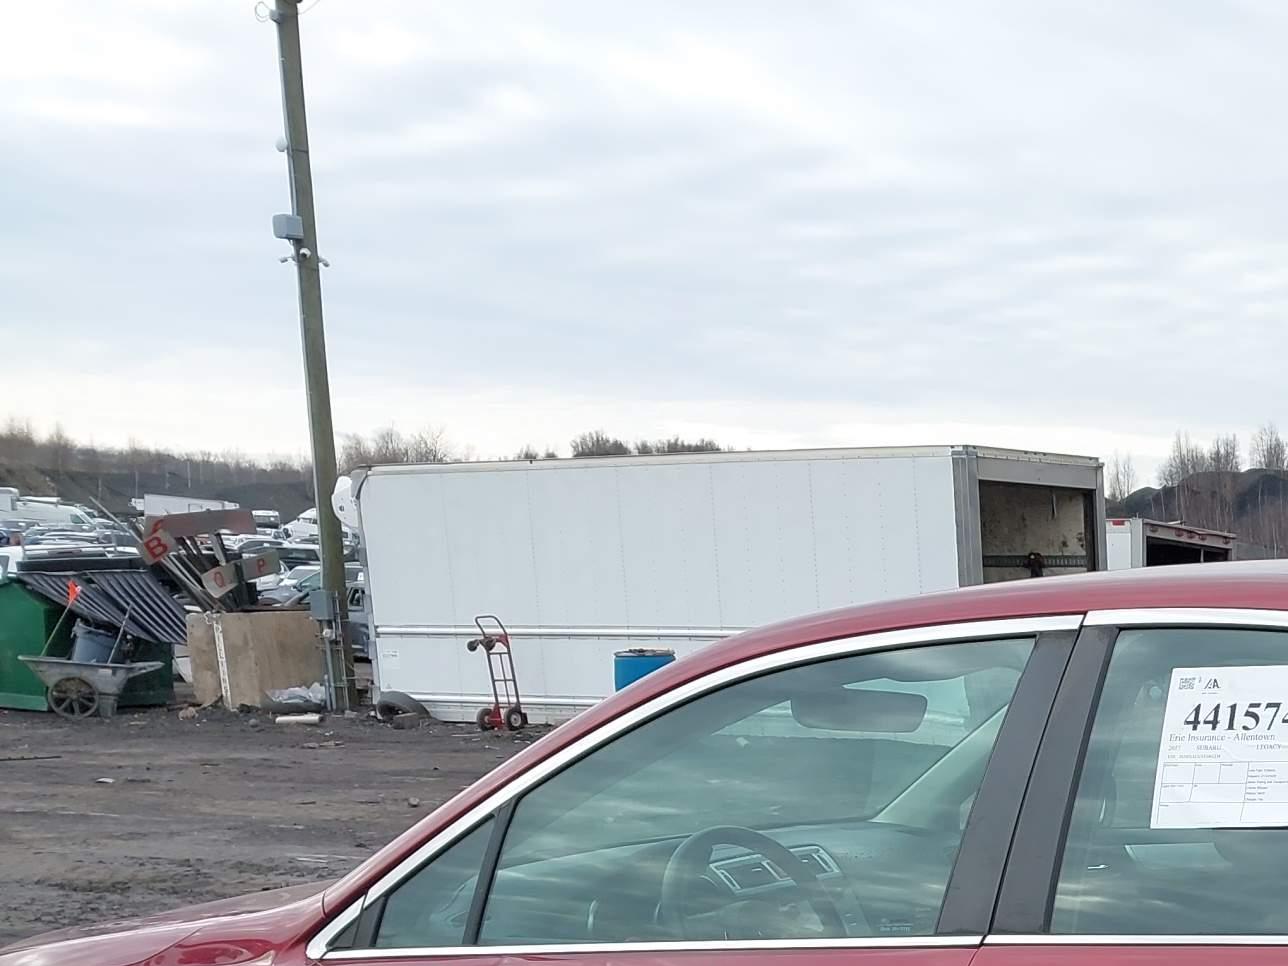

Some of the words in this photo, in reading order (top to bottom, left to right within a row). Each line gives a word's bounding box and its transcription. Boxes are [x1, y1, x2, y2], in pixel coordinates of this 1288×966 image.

[144, 536, 168, 559] B
[256, 559, 266, 573] P
[1169, 733, 1185, 742] Erie
[1187, 733, 1226, 742] Insurance
[1233, 733, 1276, 742] Allentown
